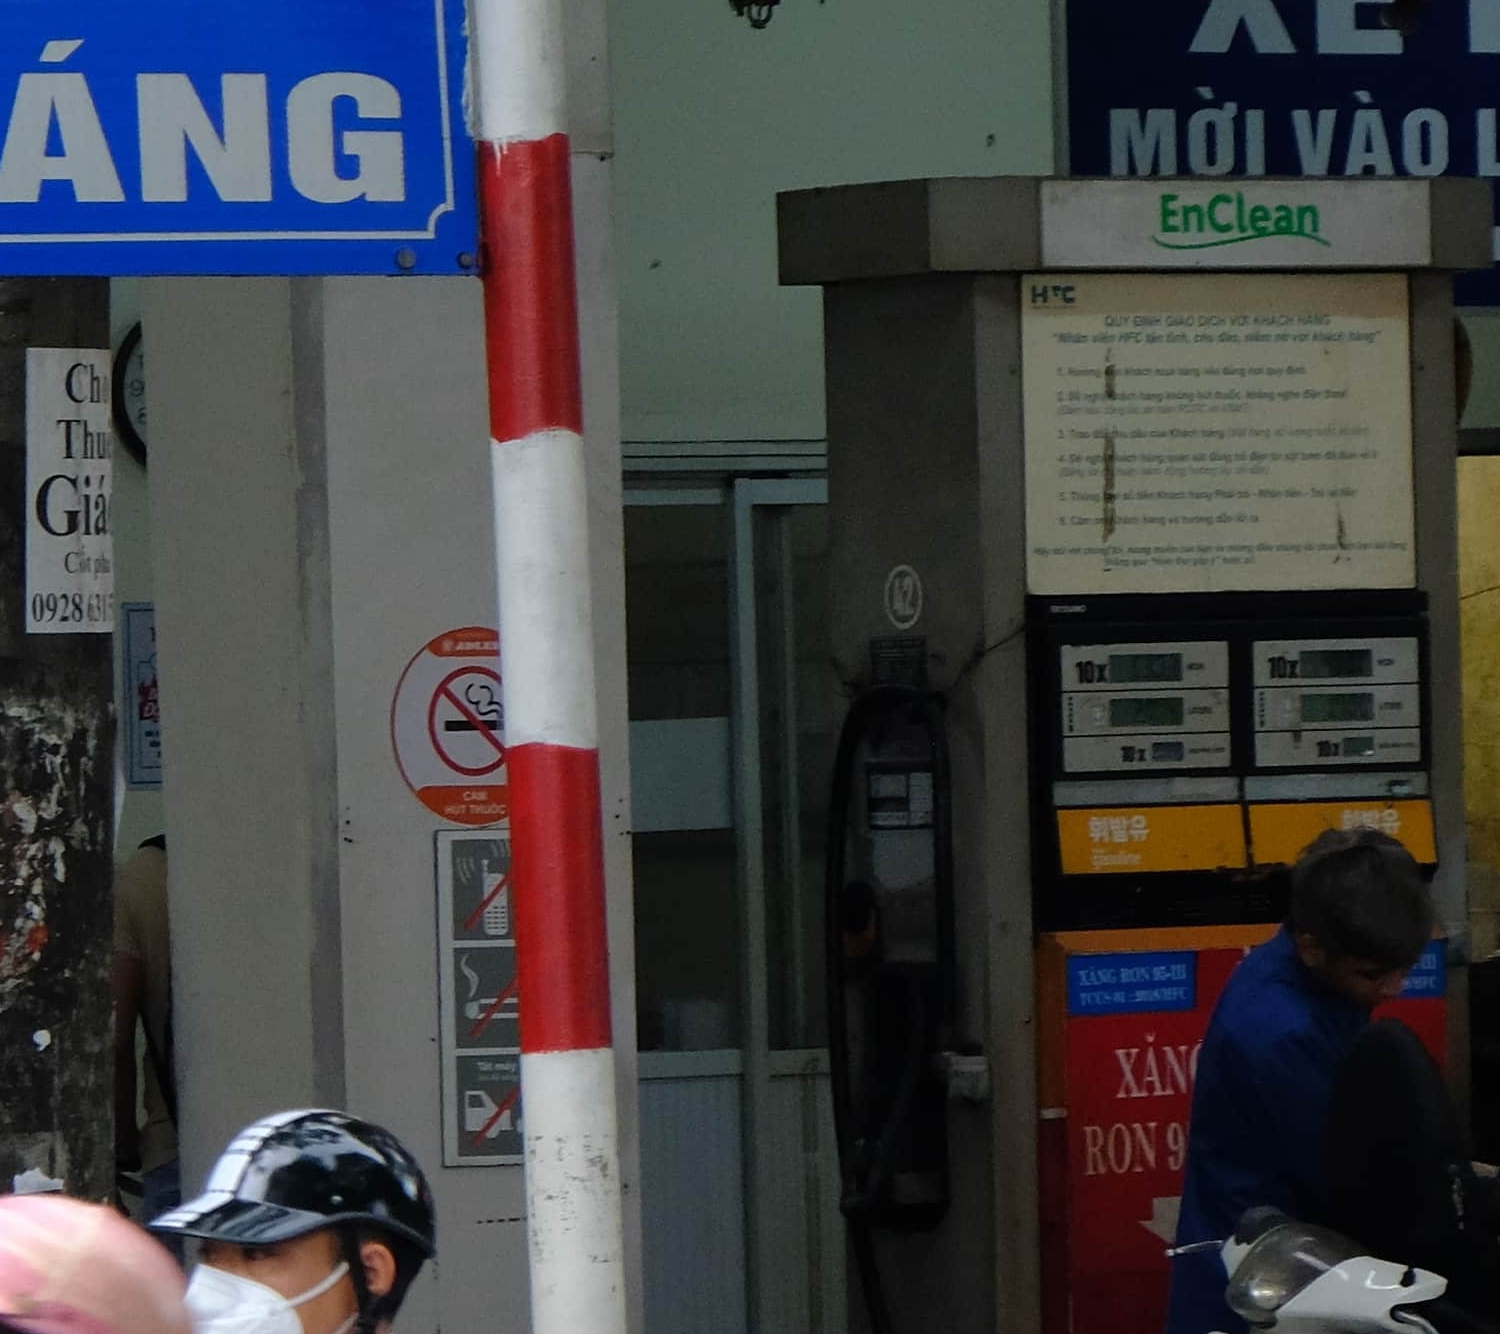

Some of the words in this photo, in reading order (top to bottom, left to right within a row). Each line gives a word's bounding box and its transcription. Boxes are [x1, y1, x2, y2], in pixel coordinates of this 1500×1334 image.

[1108, 87, 1267, 178] MỜI
[1292, 89, 1451, 179] VÀO
[1159, 193, 1320, 235] EnClean
[64, 362, 109, 404] Ch
[56, 418, 112, 460] Thu
[35, 473, 112, 537] Giá
[32, 592, 84, 623] 0928
[1083, 1121, 1157, 1176] RON
[1166, 1122, 1187, 1171] 9
